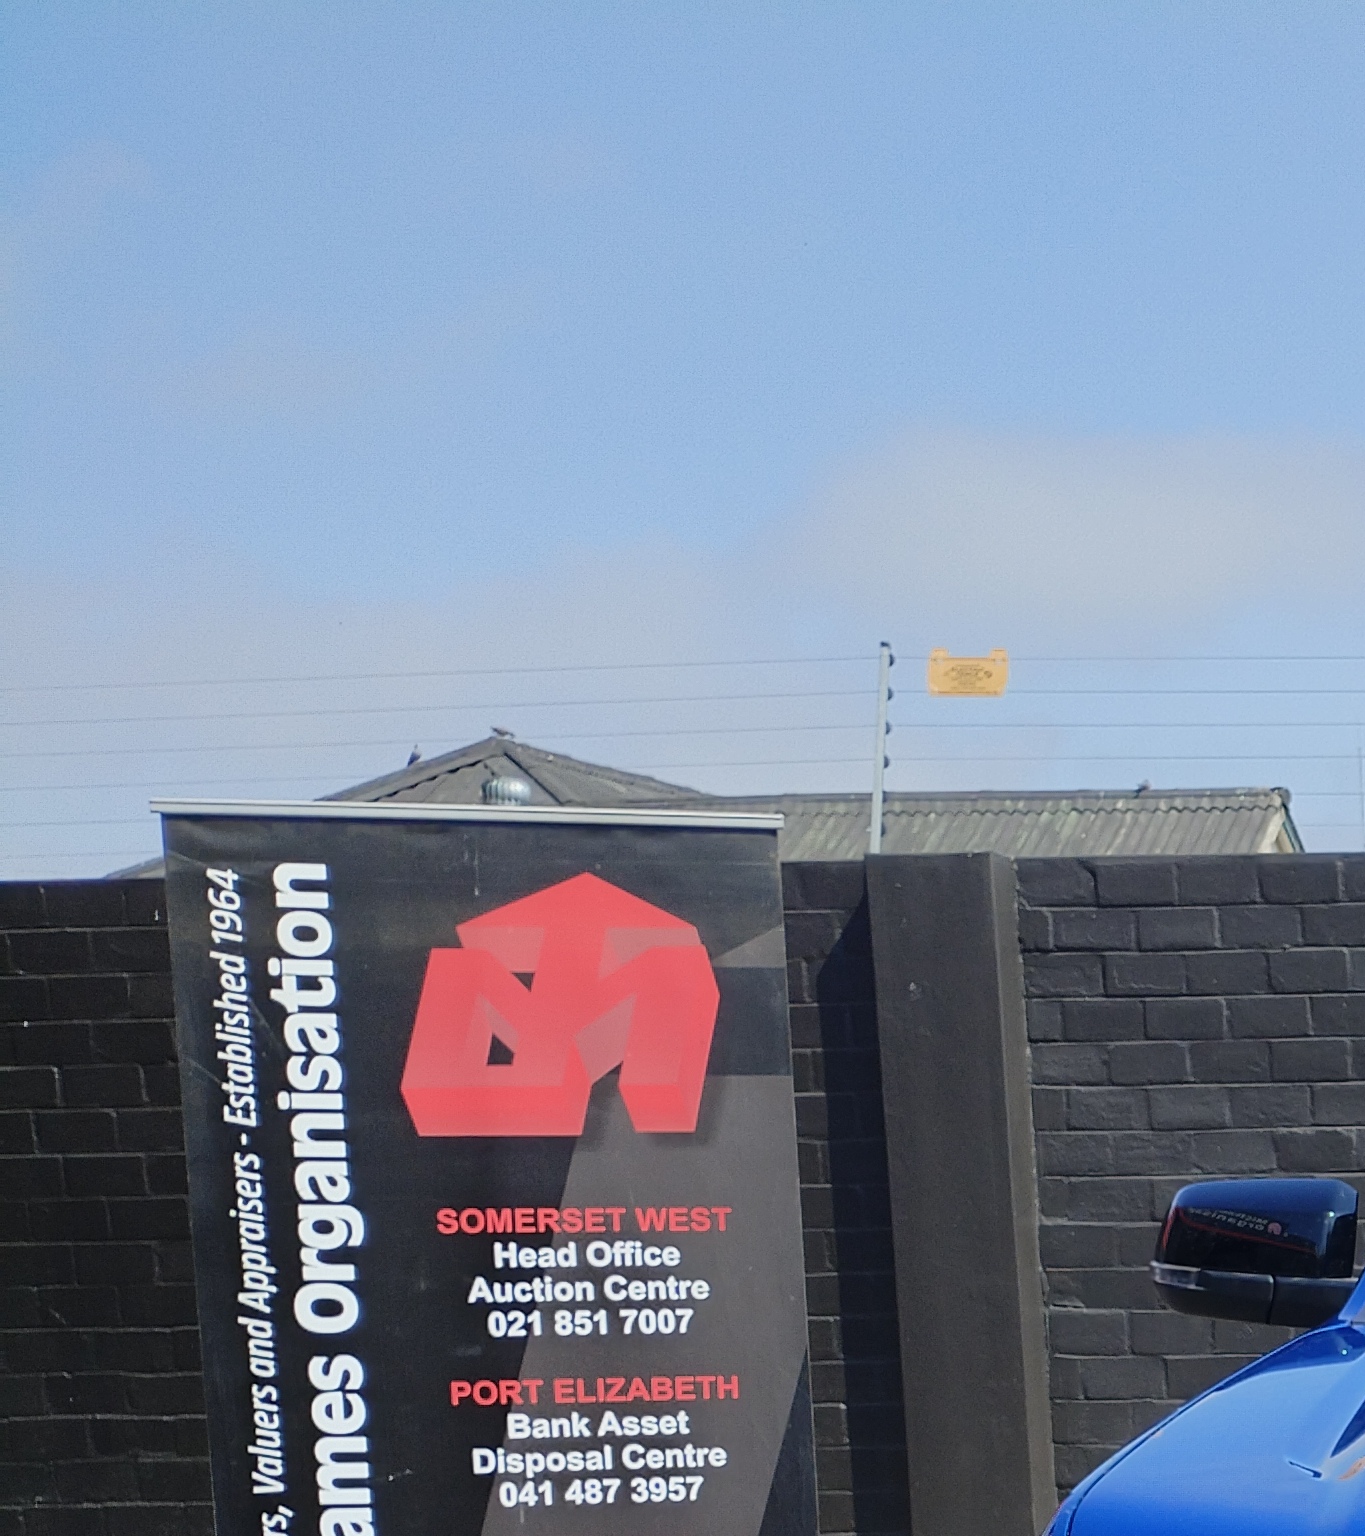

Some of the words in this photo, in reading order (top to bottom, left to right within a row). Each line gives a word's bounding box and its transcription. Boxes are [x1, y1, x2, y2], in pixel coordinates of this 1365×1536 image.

[206, 867, 241, 944] 1964
[209, 950, 257, 1127] Established
[267, 862, 365, 1334] Organisation
[229, 1151, 278, 1314] Appraisers
[436, 1207, 626, 1235] SOMERSET
[634, 1206, 731, 1232] WEST
[493, 1241, 578, 1269] Head
[585, 1240, 681, 1268] Office
[467, 1275, 595, 1304] Auction
[603, 1274, 710, 1302] Centre
[487, 1309, 542, 1338] 021
[554, 1309, 608, 1337] 851
[618, 1307, 694, 1335] 7007
[237, 1316, 276, 1378] and
[450, 1379, 544, 1406] PORT
[553, 1375, 739, 1404] ELIZABETH
[247, 1383, 285, 1494] Valuers
[506, 1411, 592, 1440] Bank
[597, 1409, 691, 1437] Asset
[472, 1444, 613, 1479] Disposal
[621, 1443, 728, 1470] Centre
[498, 1479, 553, 1508] 041
[564, 1478, 621, 1506] 487
[630, 1475, 705, 1504] 3957
